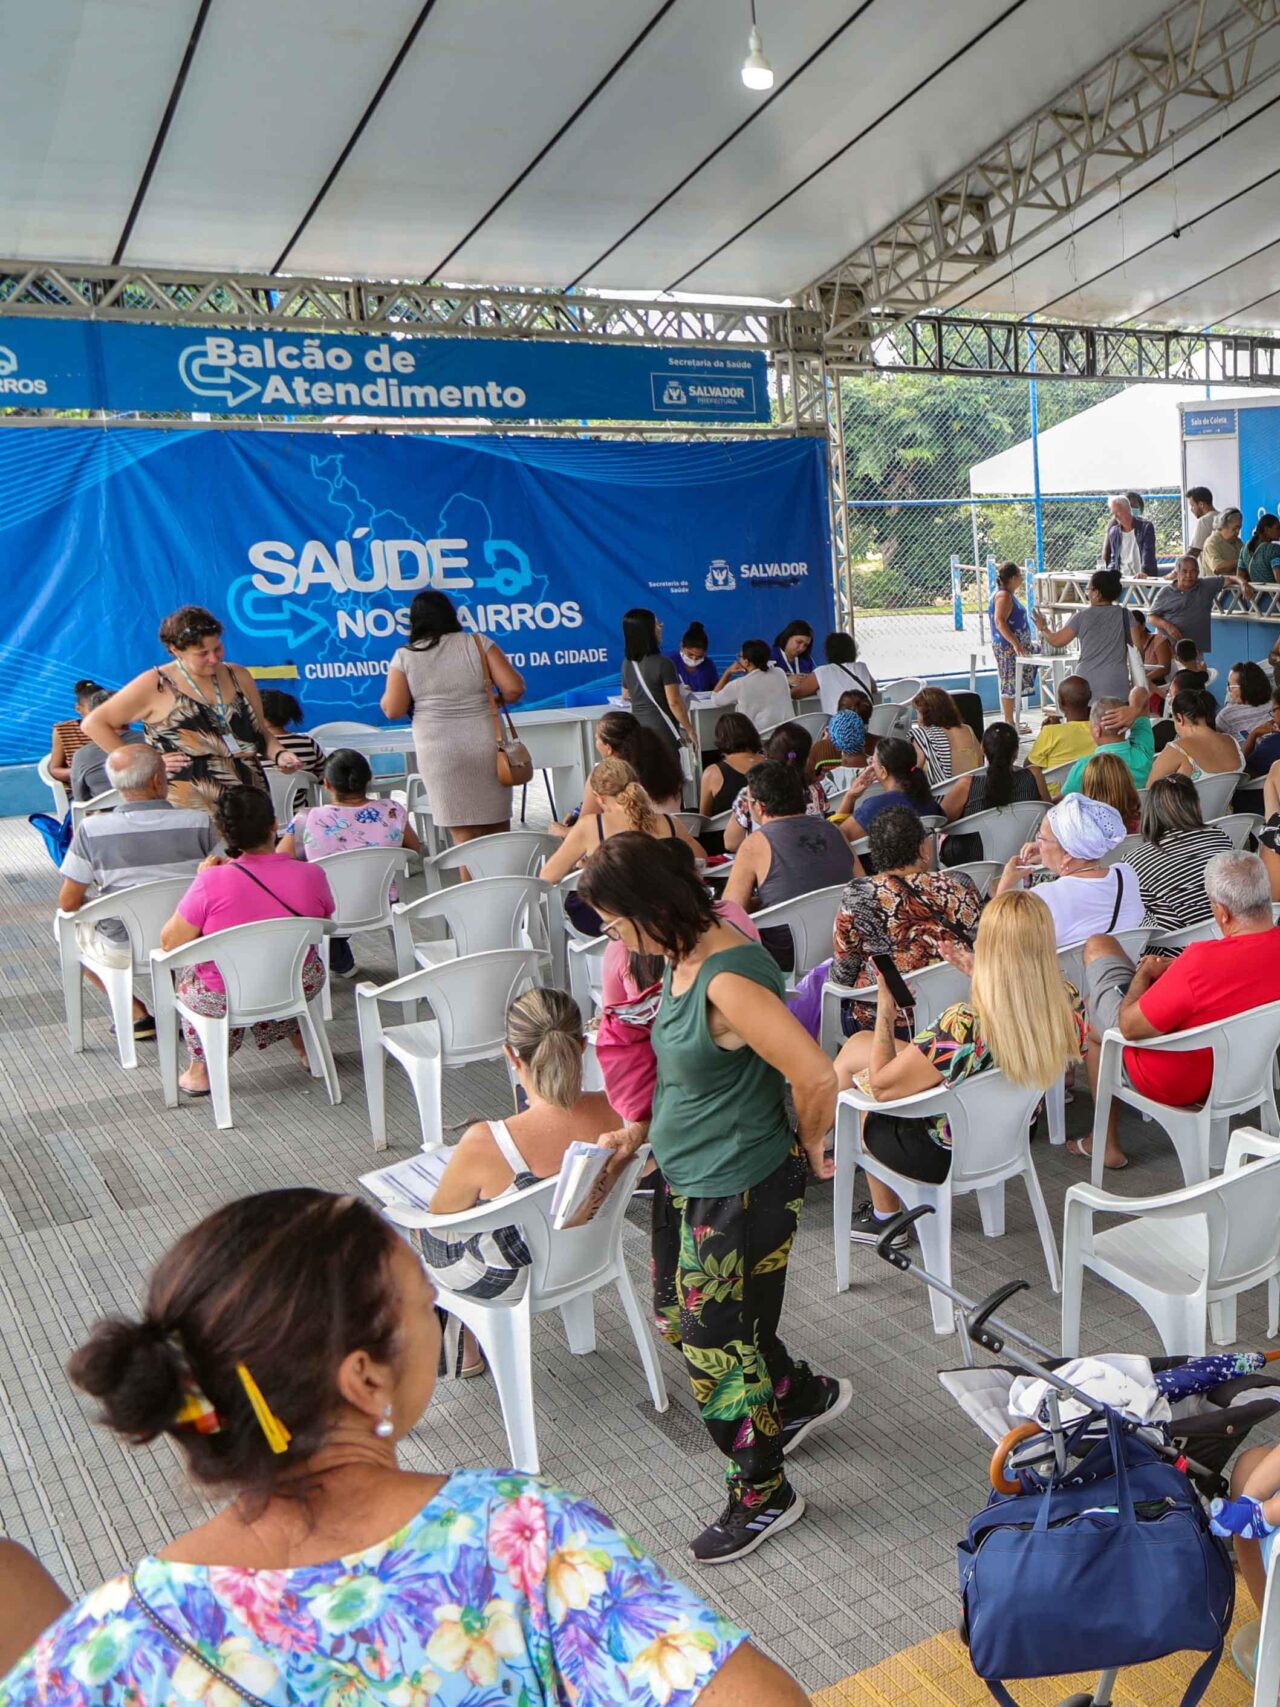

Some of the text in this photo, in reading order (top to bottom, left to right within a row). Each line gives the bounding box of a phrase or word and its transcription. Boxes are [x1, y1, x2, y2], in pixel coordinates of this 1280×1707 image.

[205, 337, 416, 374] Balcão de
[668, 357, 752, 369] Secretaria da Saúde
[261, 375, 526, 409] Atendimento
[688, 385, 745, 398] SALVADOR
[248, 527, 475, 595] SAÚDE
[740, 562, 808, 578] SALVADOR
[337, 601, 583, 639] NOS AIRROS
[304, 660, 391, 680] CUIDANDO
[530, 652, 551, 667] DA
[554, 648, 608, 665] CIDADE
